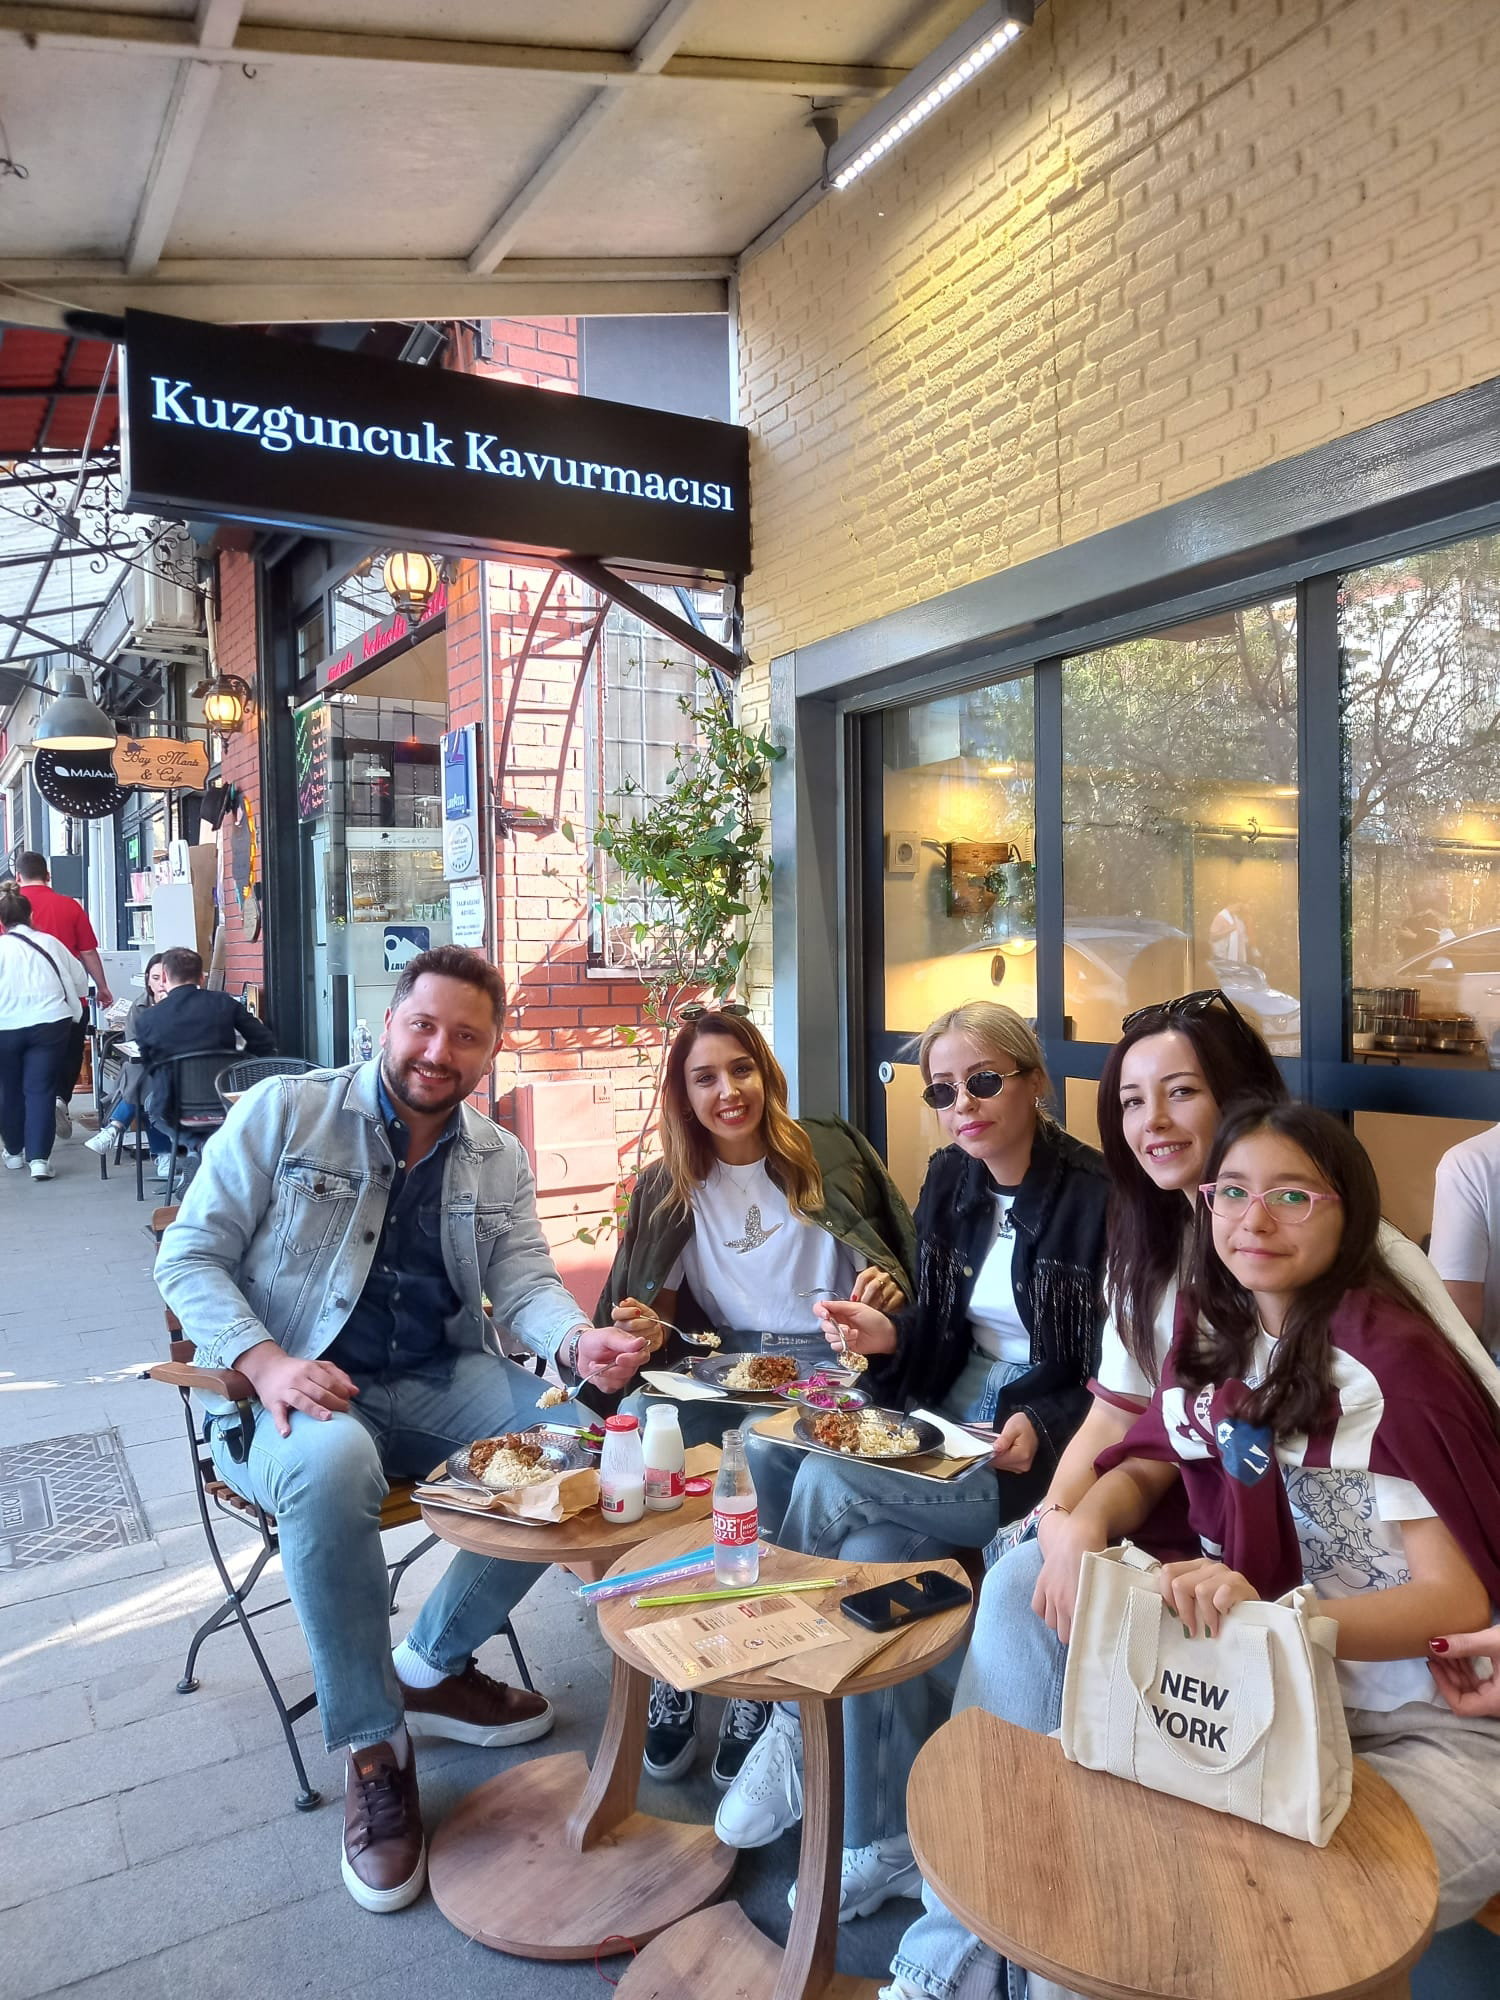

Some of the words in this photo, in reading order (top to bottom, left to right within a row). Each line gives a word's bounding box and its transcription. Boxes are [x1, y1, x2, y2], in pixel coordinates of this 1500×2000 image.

[150, 376, 456, 467] Kuzguncuk
[465, 431, 735, 511] Kavurmacısı
[121, 750, 150, 767] Bay
[141, 769, 152, 780] &
[156, 767, 183, 785] Cafe
[1160, 1669, 1230, 1711] NEW
[1151, 1704, 1229, 1753] YORK
